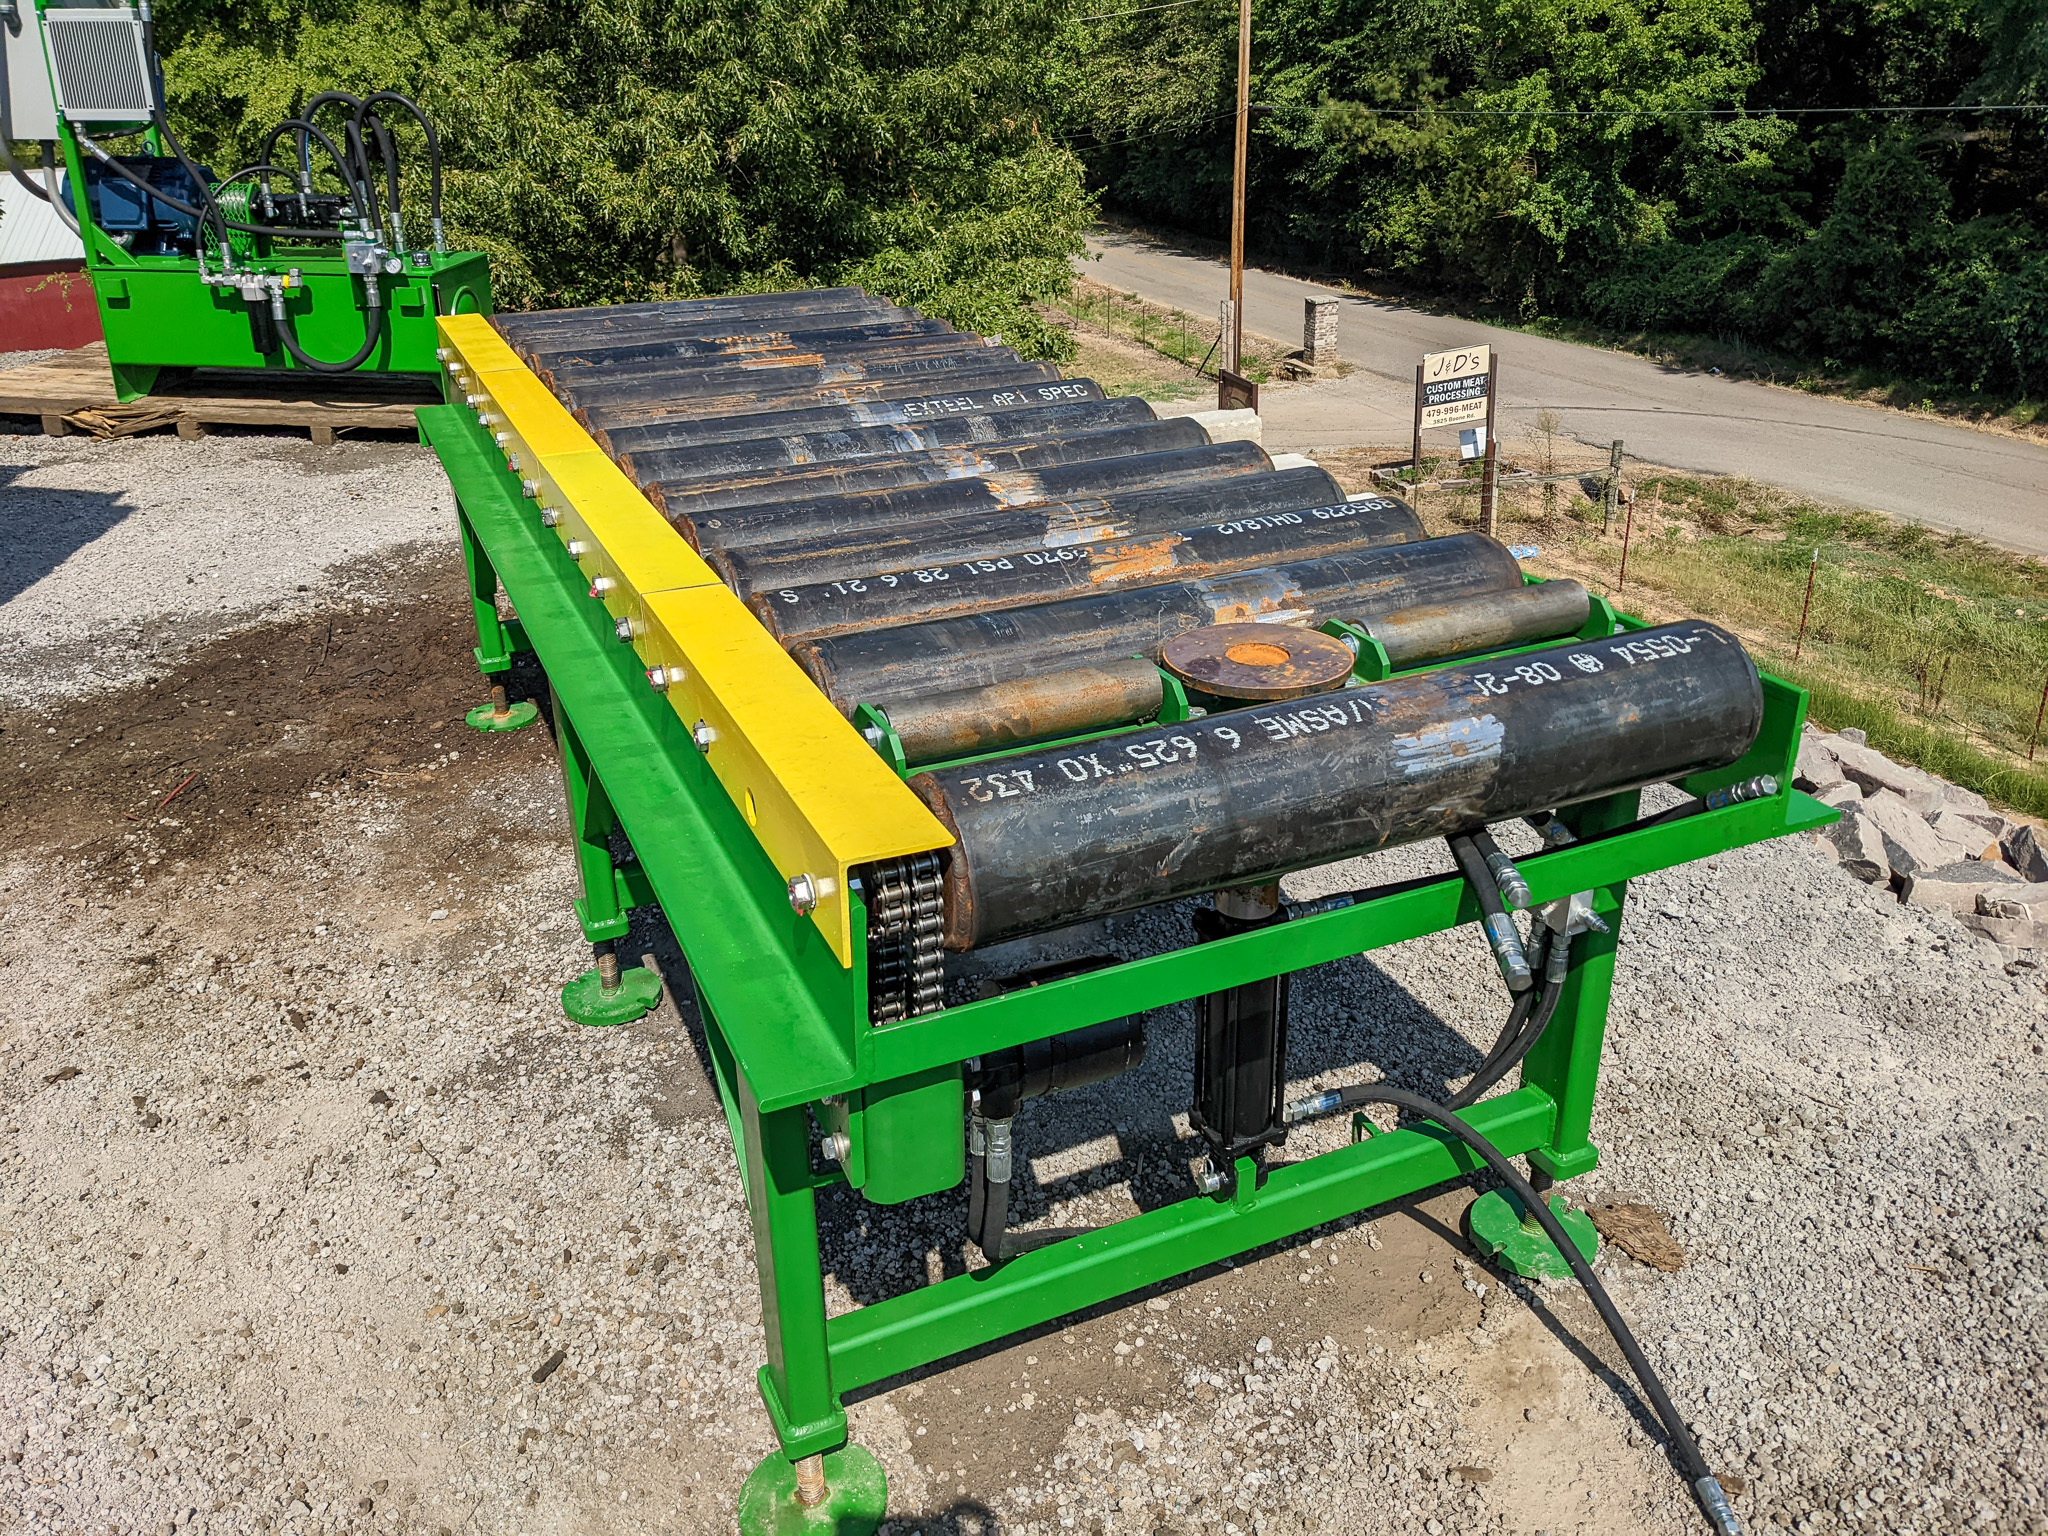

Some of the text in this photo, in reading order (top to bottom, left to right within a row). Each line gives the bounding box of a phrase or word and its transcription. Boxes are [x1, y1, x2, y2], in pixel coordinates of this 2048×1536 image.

[1426, 376, 1485, 395] CUSTOM MEAT
[902, 396, 984, 417] EXTEEL
[1038, 384, 1089, 401] SPEC
[1428, 387, 1481, 404] PROCESSING
[1426, 401, 1483, 418] 479-996-MEAT
[965, 557, 1015, 575] PSI
